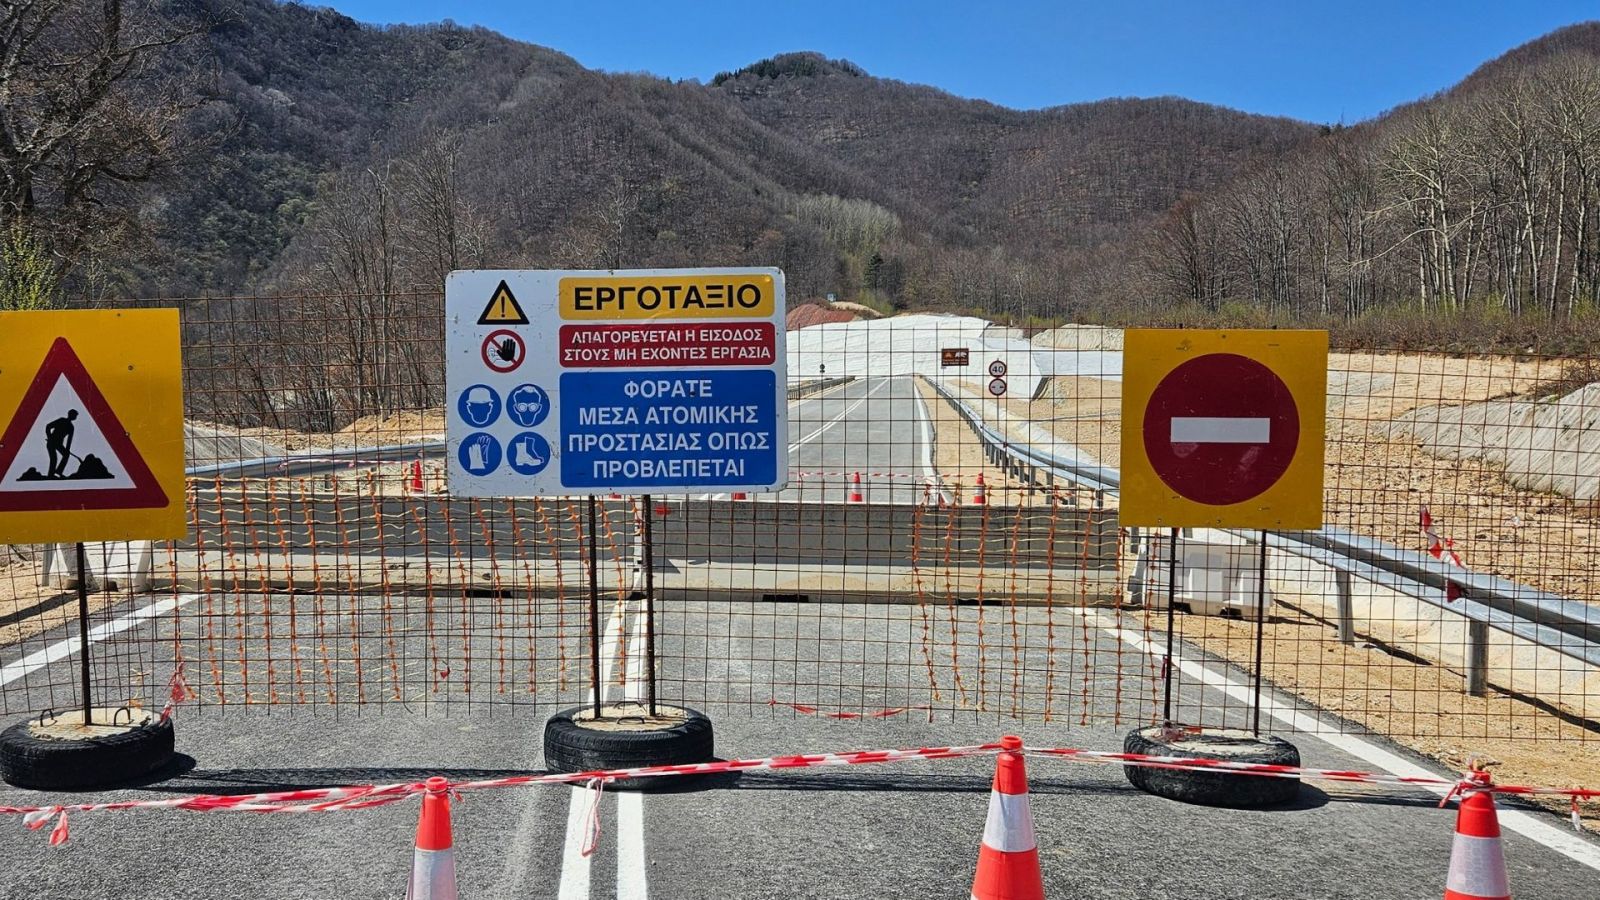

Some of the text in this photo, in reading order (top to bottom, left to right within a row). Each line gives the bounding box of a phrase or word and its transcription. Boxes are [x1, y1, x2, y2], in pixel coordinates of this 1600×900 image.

[574, 283, 762, 311] ΕΡΓΟΤΑΞΙΟ
[685, 329, 695, 342] Η
[699, 328, 763, 342] ΕΙΣΟΔΟΣ
[564, 346, 771, 361] ΣΤΟΥΣ ΜΗ ΕΧΟΝΤΕΣ ΕΡΓΑΣΙΑ
[992, 365, 1004, 373] 40
[624, 379, 713, 398] ΦΟΡΑΤΕ
[579, 405, 759, 425] ΜΕΣΑ ΑΤΟΜΙΚΗΣ
[569, 432, 770, 452] ΠΡΟΣΤΑΣΙΑΣ ΟΠΩΣ
[593, 459, 745, 478] ΠΡΟΒΛΕΠΕΤΑΙ
